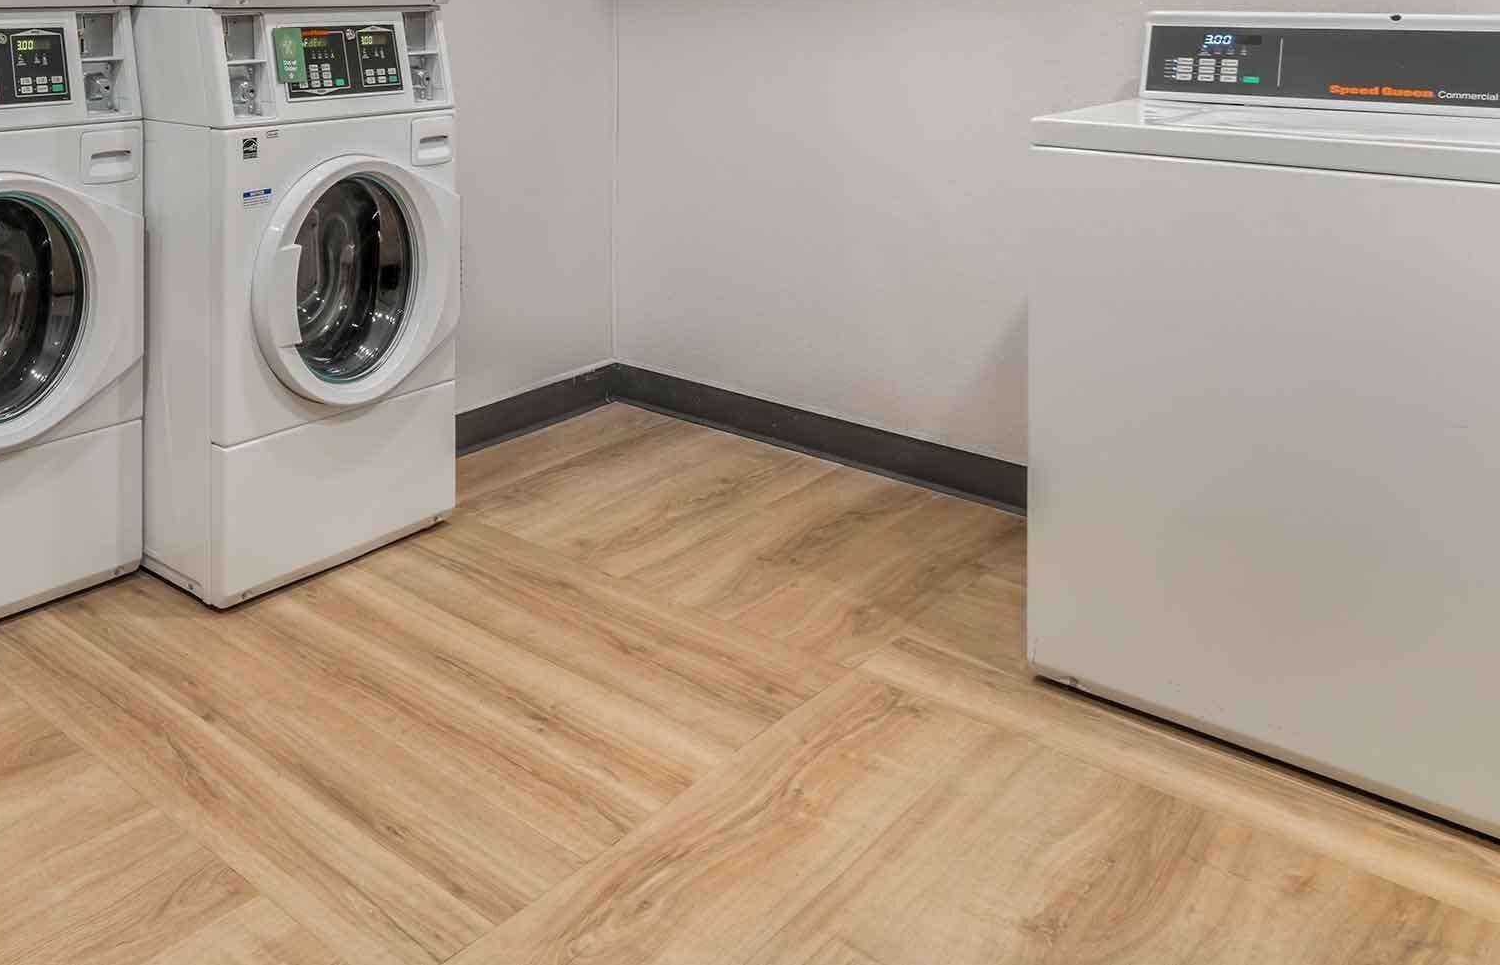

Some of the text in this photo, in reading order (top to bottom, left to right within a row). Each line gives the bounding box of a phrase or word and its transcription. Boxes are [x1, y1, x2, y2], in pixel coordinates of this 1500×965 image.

[16, 40, 34, 50] 3.00
[1204, 34, 1232, 45] 3.00
[1329, 84, 1500, 101] Speed Queen Commercial
